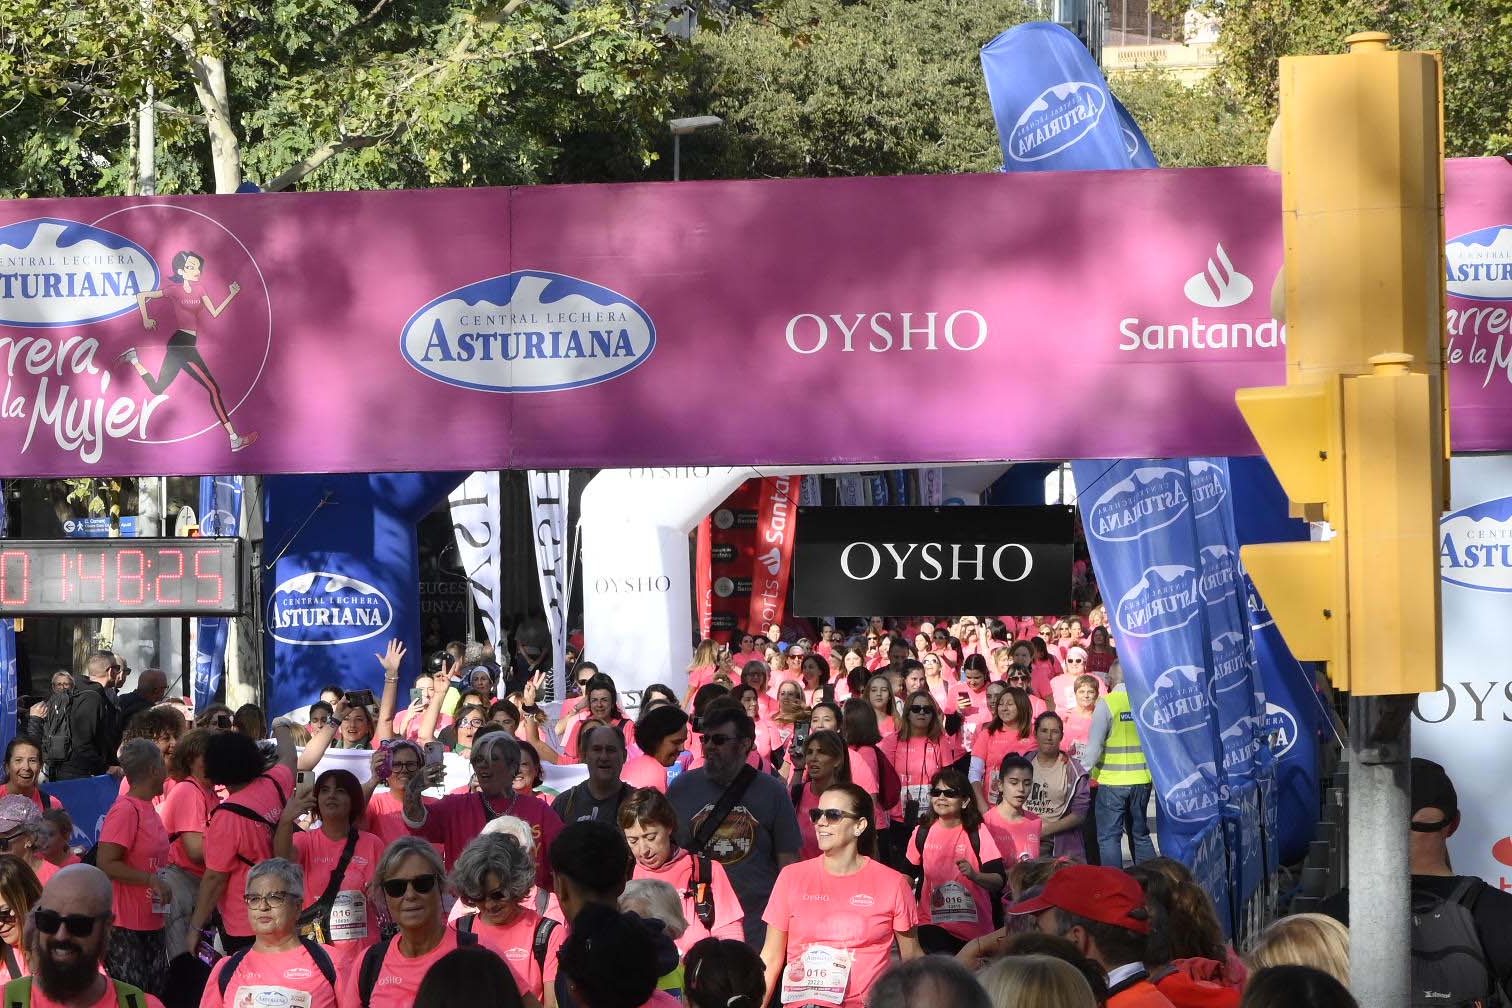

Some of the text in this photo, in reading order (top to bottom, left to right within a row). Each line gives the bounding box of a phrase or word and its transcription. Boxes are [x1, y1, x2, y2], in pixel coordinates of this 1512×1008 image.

[62, 254, 134, 266] LECHERA
[460, 312, 627, 326] CENTRAL LECHERA
[421, 318, 636, 361] ASTURIANA
[785, 310, 988, 354] OYSHO
[1, 379, 26, 419] la
[21, 371, 170, 464] Mujer
[840, 541, 1033, 582] OYSHO
[595, 576, 671, 593] OYSHO
[283, 596, 379, 607] CENTRAL LECHERA
[272, 602, 383, 629] ASTURIANA
[807, 968, 826, 977] 016
